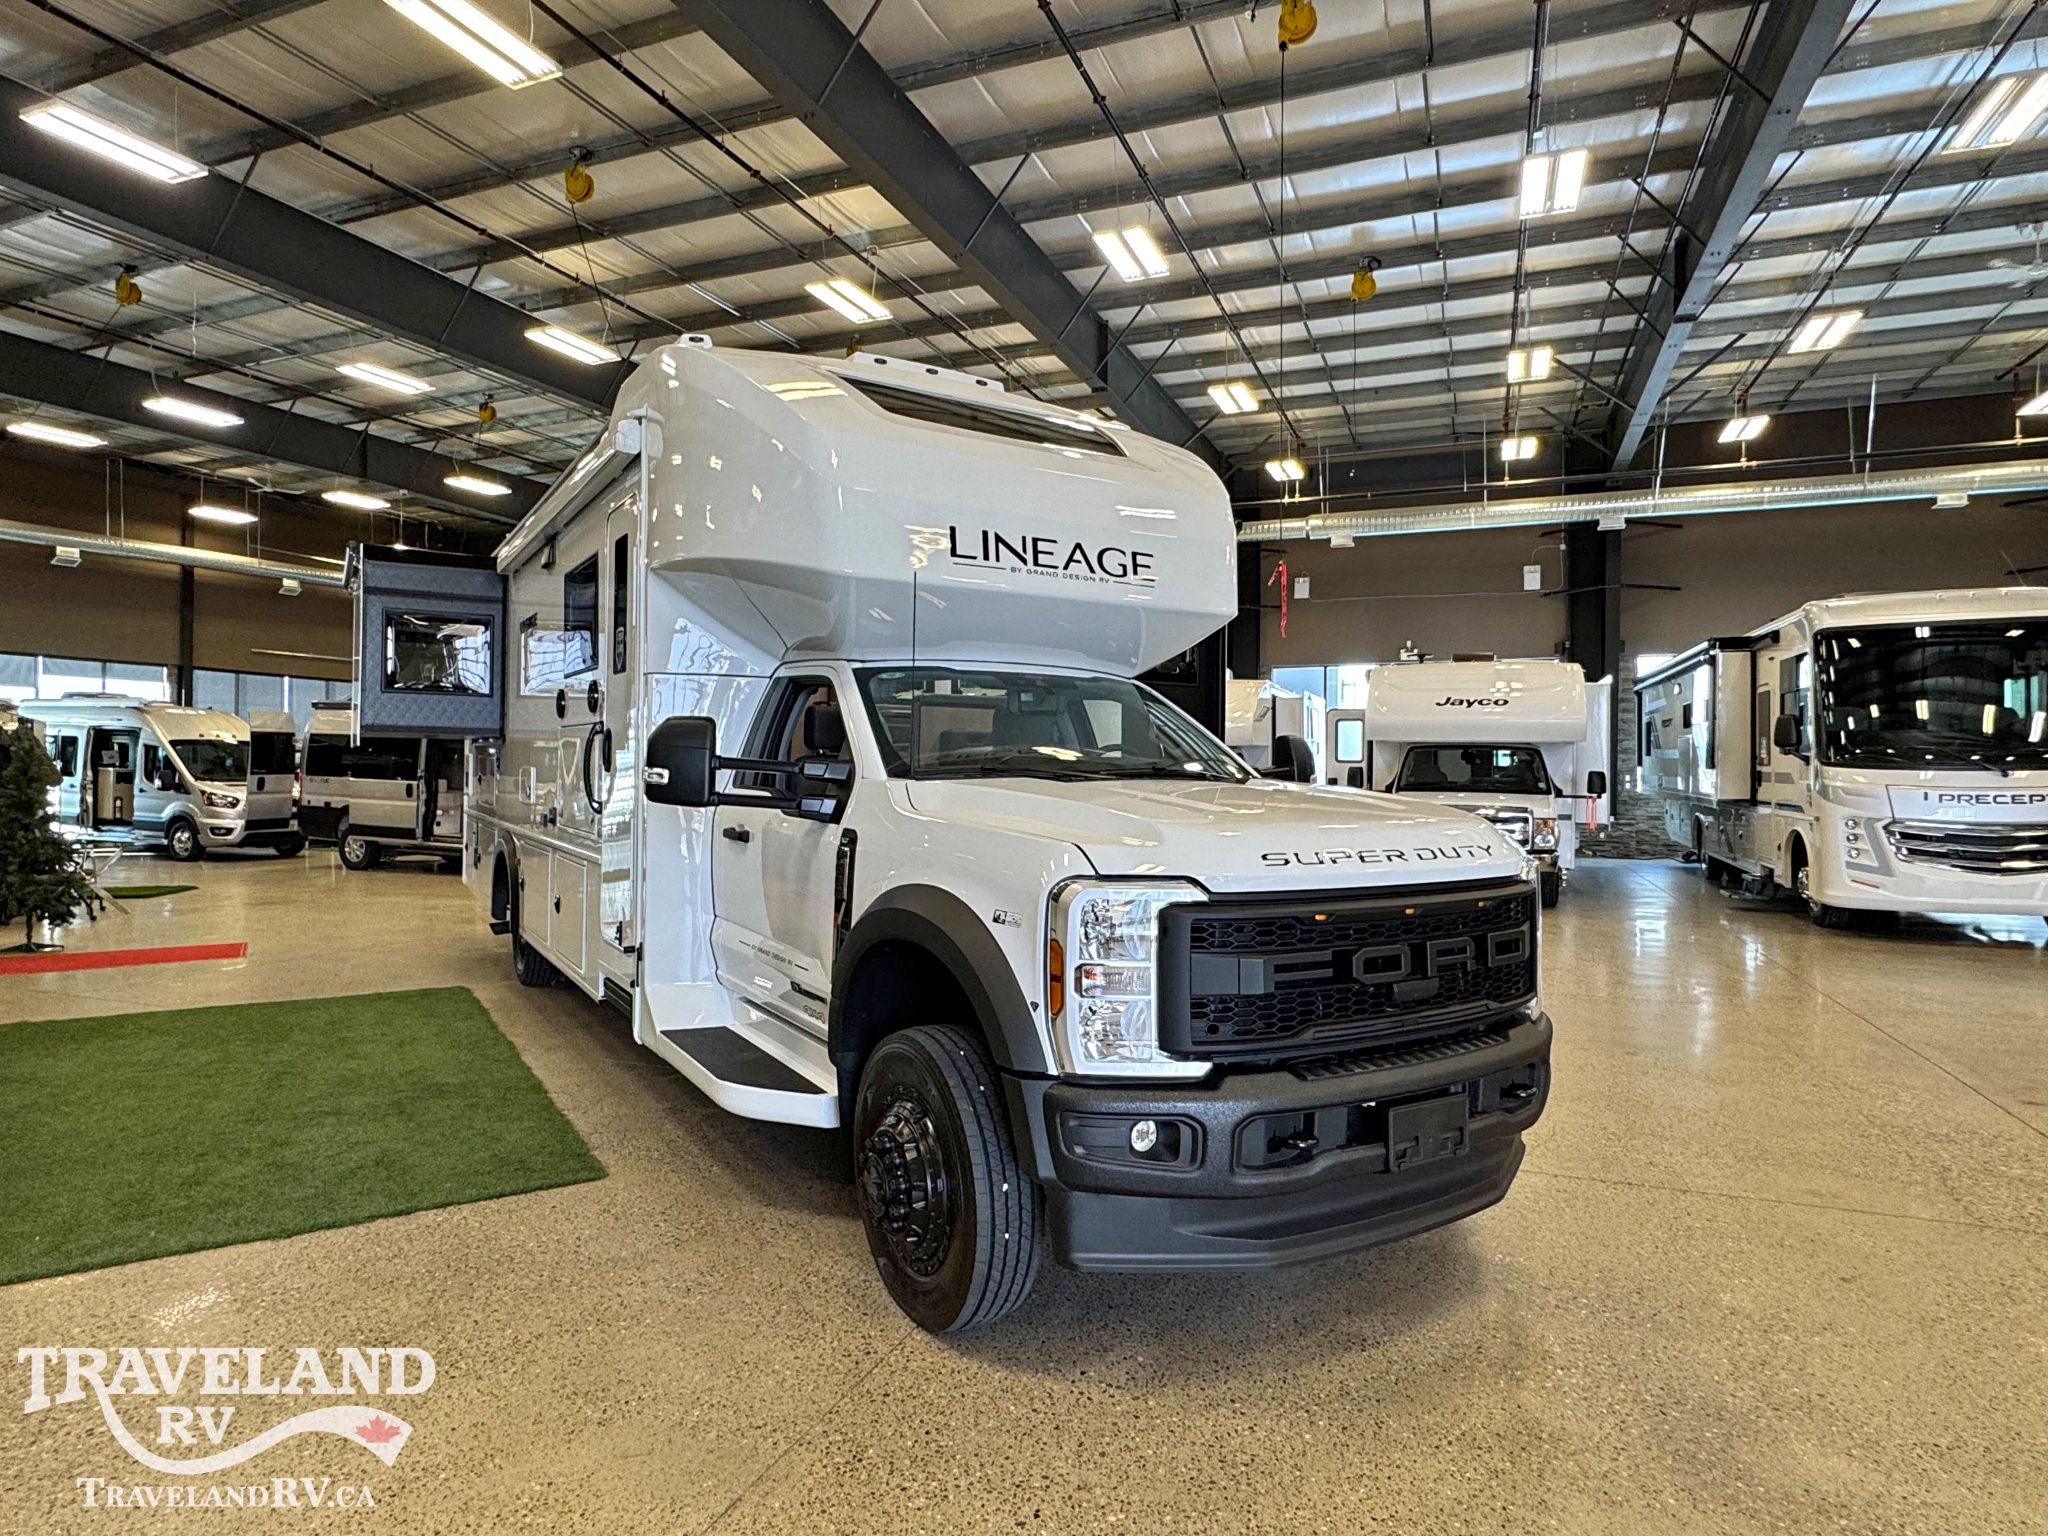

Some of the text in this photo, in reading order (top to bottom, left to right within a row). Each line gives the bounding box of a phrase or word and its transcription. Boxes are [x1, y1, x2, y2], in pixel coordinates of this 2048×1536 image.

[949, 525, 1155, 582] LINEAGE
[1010, 566, 1022, 574] BY
[1026, 568, 1059, 578] GRAND
[1062, 573, 1096, 582] DESIGN
[1435, 696, 1510, 709] Jayco
[1938, 793, 2048, 806] PRECEP
[1260, 845, 1492, 867] SUPER DUTY
[1262, 920, 1531, 995] FORD
